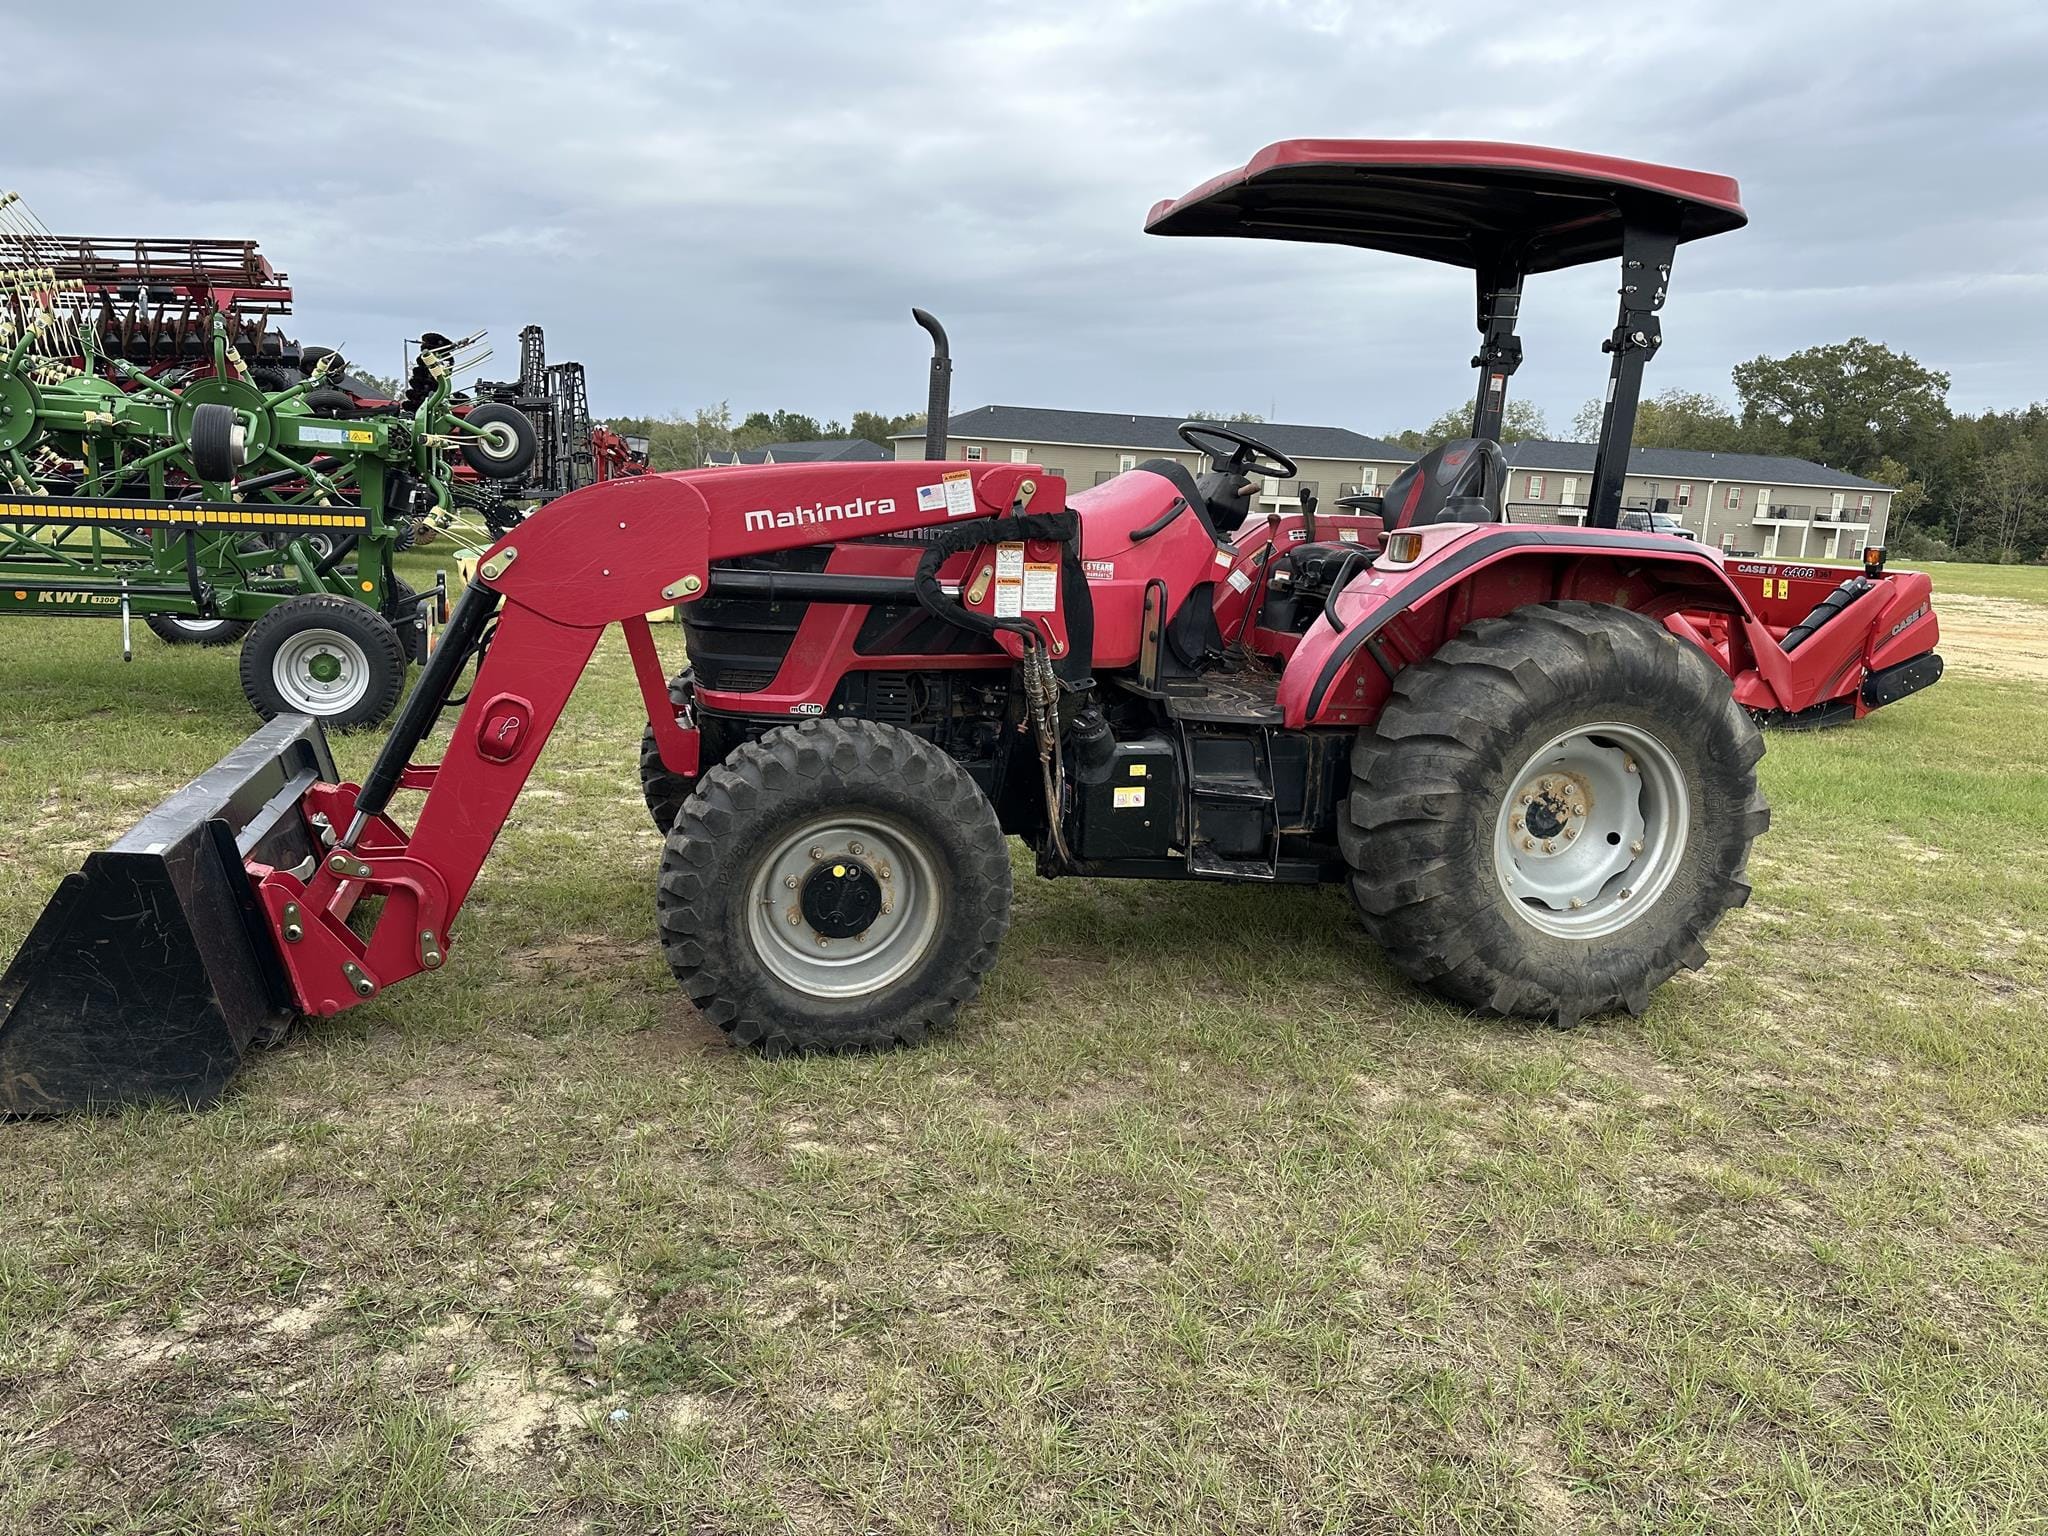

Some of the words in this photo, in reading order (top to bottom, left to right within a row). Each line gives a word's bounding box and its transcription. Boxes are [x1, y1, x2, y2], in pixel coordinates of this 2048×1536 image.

[744, 497, 896, 532] Mahindra
[1737, 564, 1765, 574] CASE
[1781, 566, 1815, 579] 4408
[37, 591, 93, 604] KWT
[1891, 609, 1920, 636] CASE
[1663, 868, 1691, 906] LUG
